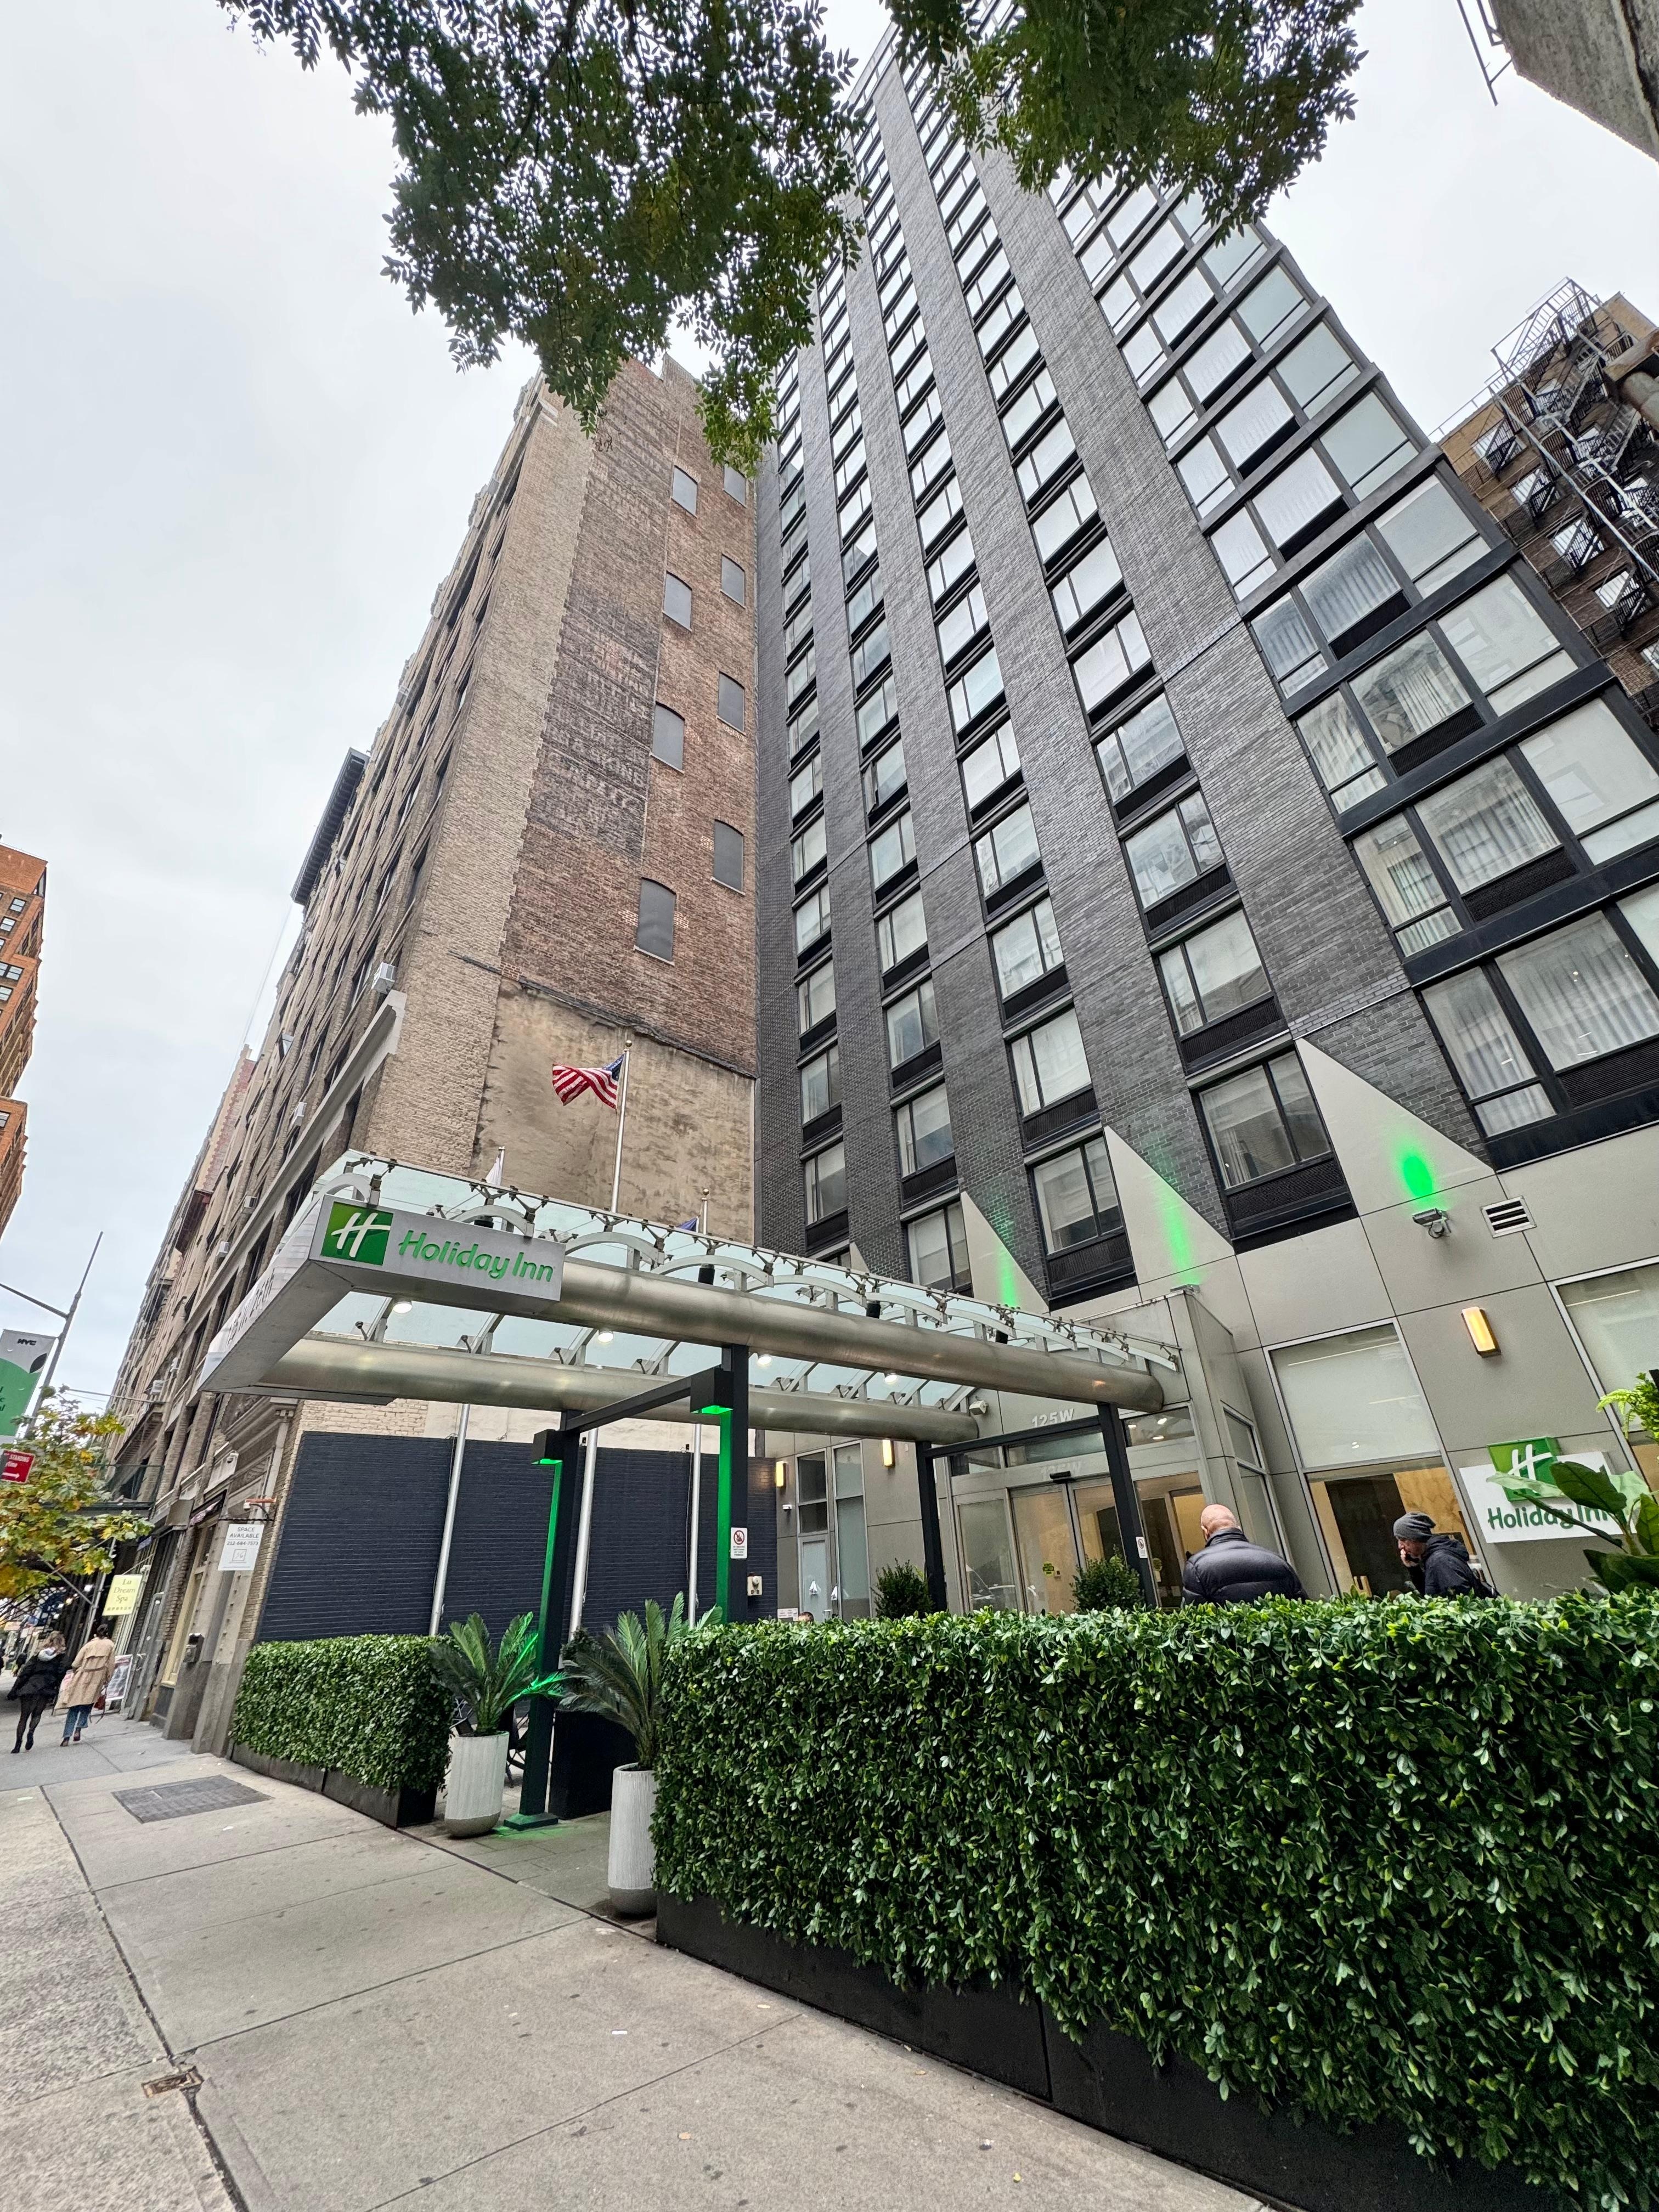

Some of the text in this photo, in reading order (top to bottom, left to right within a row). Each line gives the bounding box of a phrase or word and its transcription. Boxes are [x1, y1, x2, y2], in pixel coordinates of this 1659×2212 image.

[398, 1230, 554, 1283] Holiday Inn
[116, 1595, 128, 1604] Spa
